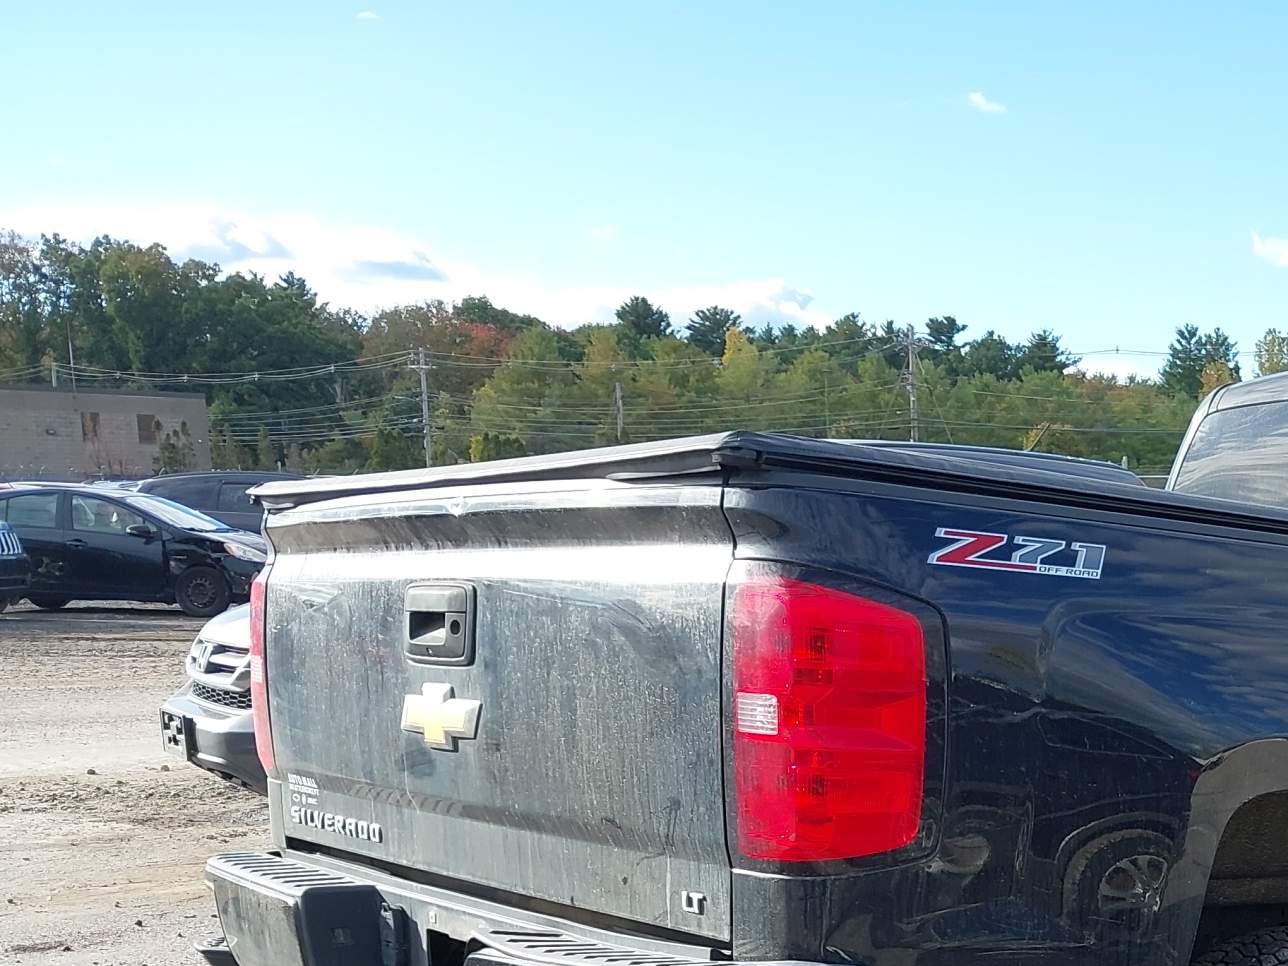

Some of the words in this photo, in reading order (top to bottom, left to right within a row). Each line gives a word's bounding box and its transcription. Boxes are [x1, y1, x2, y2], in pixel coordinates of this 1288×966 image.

[927, 527, 1107, 574] Z71
[1039, 565, 1063, 574] OFF
[1065, 568, 1099, 578] ROAD
[290, 805, 382, 843] SILVERADO
[681, 890, 704, 914] LT
